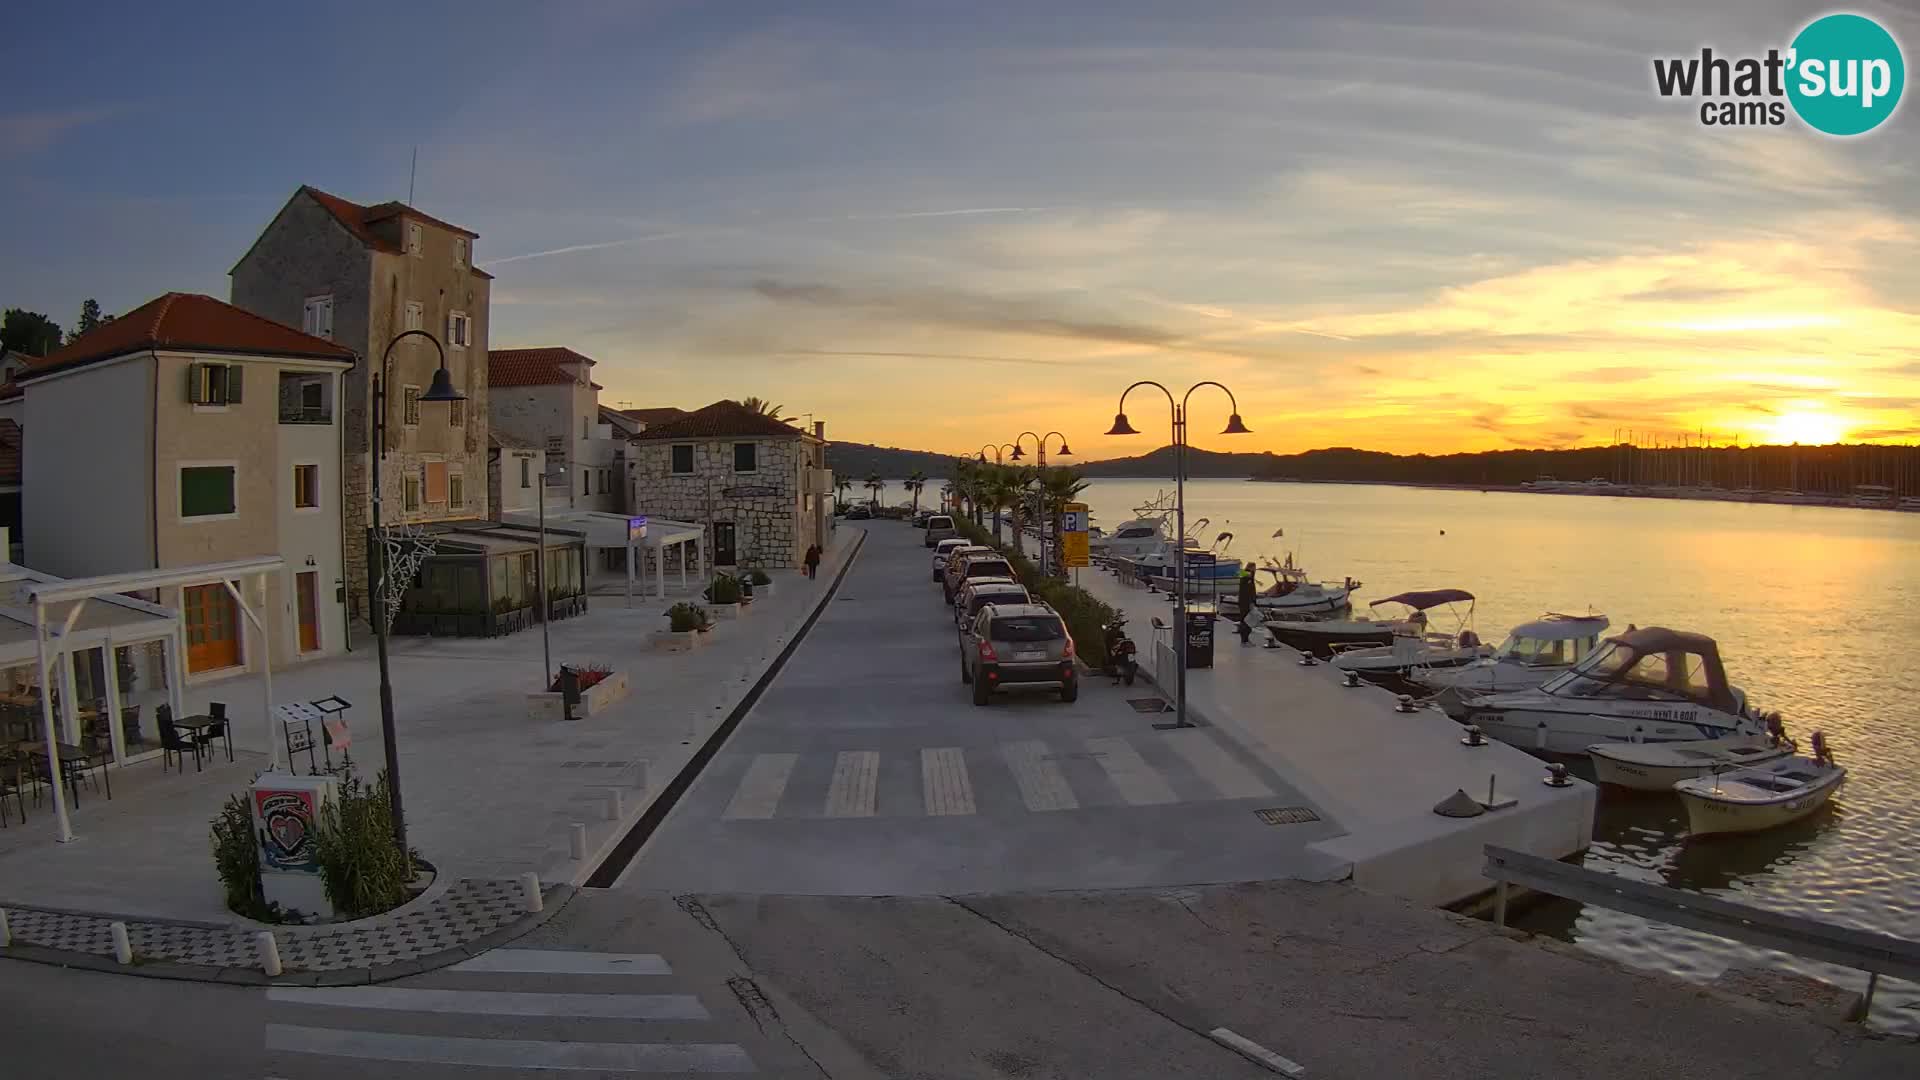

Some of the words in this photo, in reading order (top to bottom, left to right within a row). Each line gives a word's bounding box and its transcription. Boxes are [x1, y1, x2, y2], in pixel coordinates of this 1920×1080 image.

[1065, 513, 1076, 530] P
[1653, 709, 1673, 720] RENT
[1680, 711, 1698, 721] BOAT
